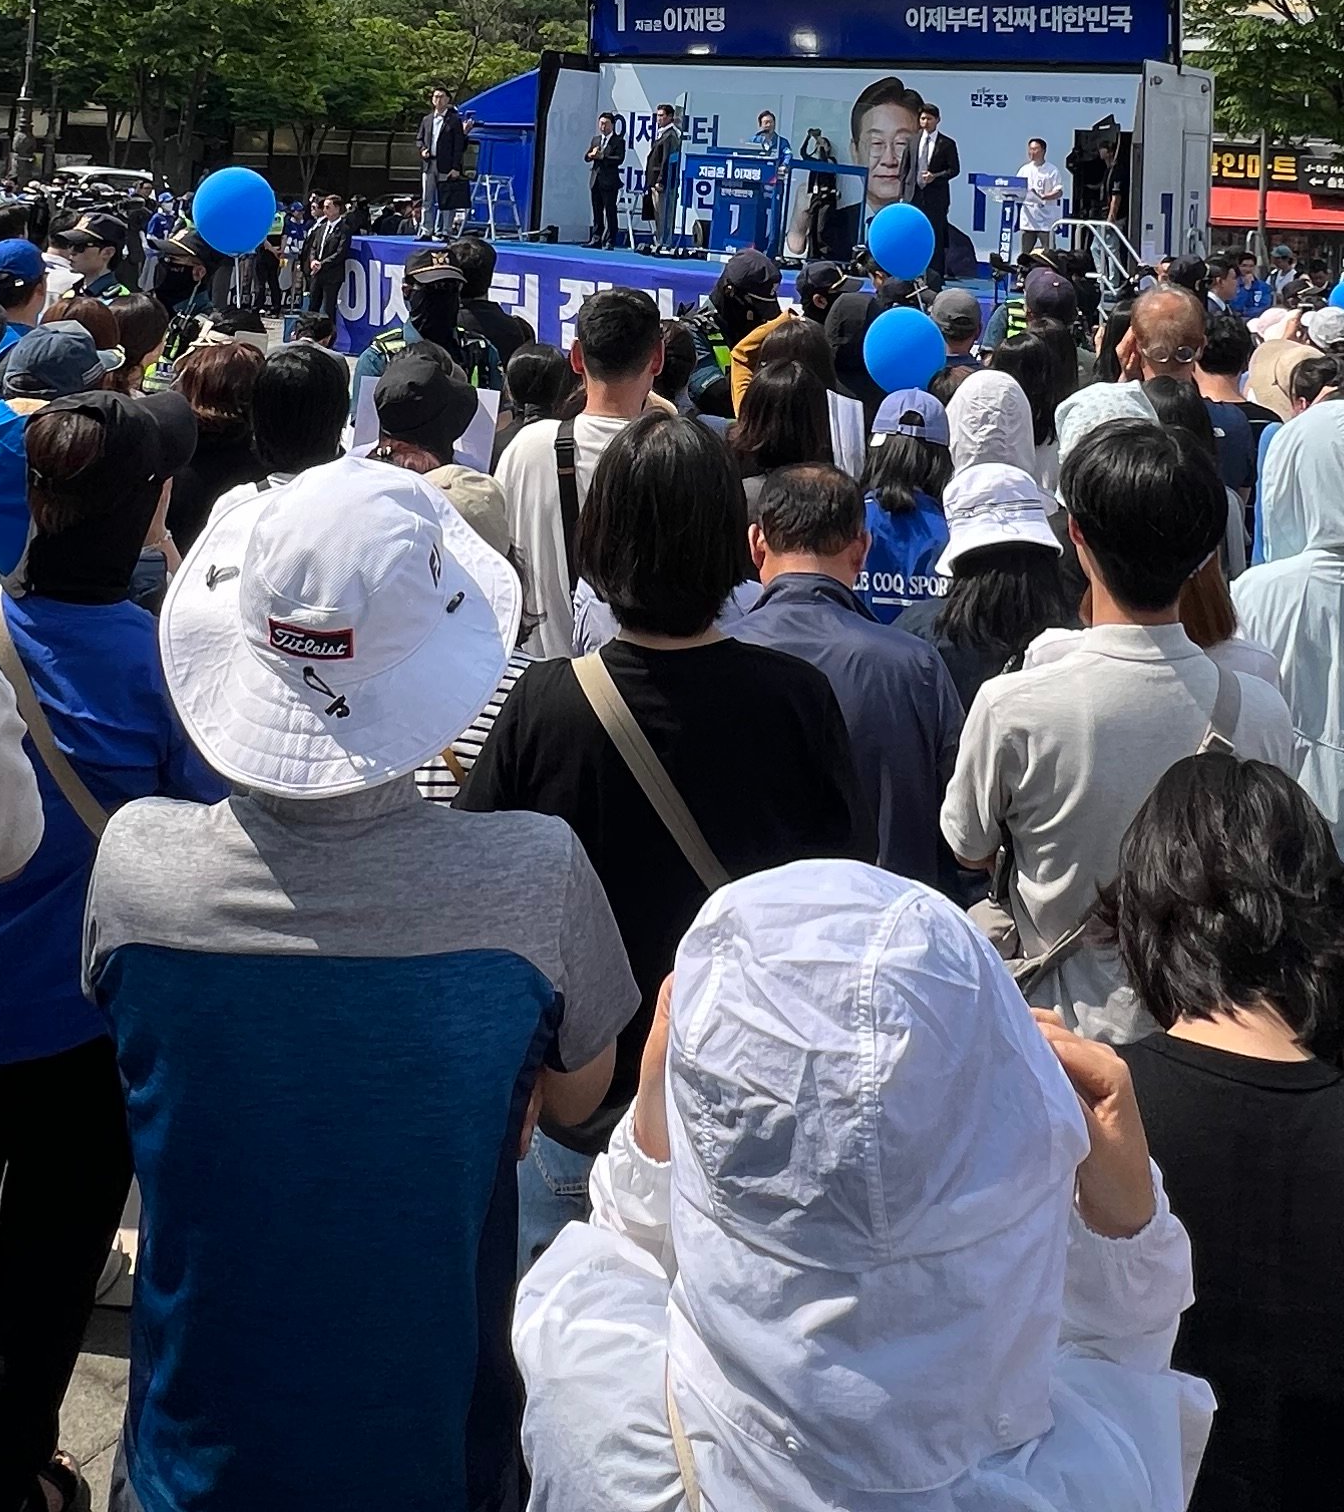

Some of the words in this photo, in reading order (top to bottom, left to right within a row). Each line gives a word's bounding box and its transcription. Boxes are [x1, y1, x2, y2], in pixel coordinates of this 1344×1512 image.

[663, 8, 726, 32] 이재명
[906, 6, 988, 32] 이제부터
[992, 6, 1037, 33] 진짜
[1040, 5, 1133, 33] 대한민국
[970, 93, 1009, 108] 민주당
[726, 159, 733, 179] 1
[729, 204, 740, 235] 1
[872, 572, 905, 595] COQ
[909, 576, 950, 597] SPOR
[272, 628, 349, 656] Titleist
